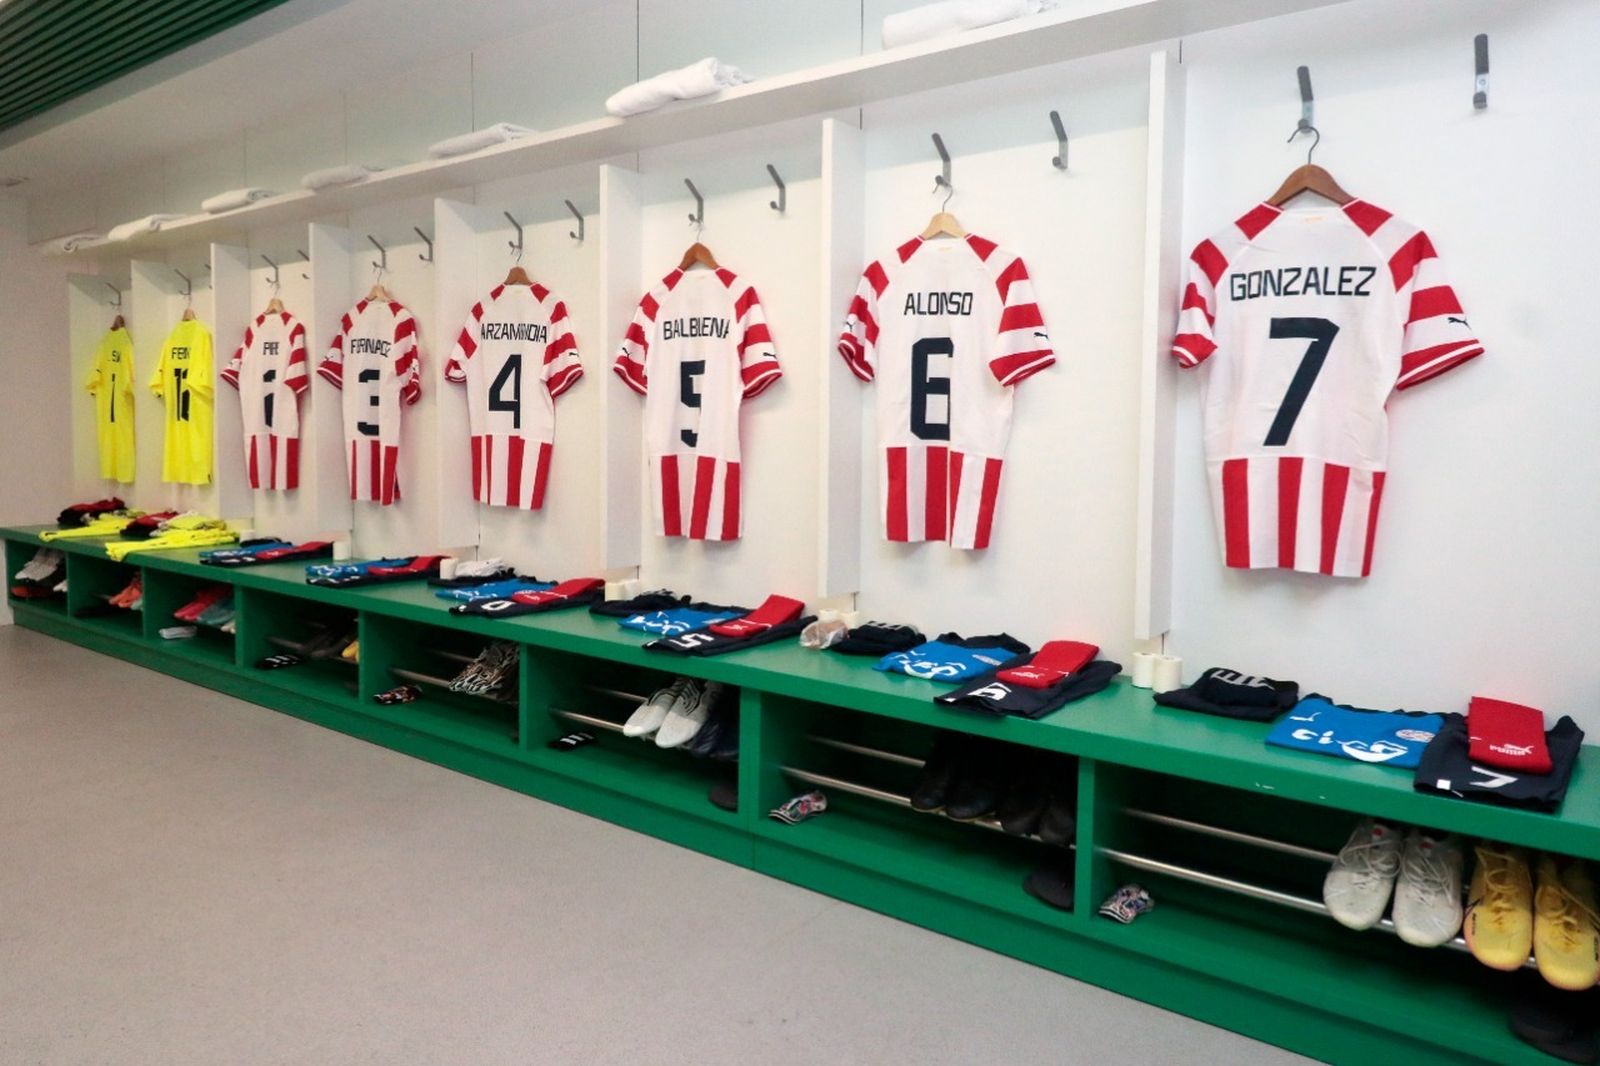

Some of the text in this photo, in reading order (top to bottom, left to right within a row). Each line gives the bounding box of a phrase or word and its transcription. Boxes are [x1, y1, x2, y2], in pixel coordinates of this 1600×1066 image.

[904, 291, 973, 316] ALONSO
[1230, 266, 1377, 301] GONZALEZ
[357, 368, 380, 436] 3
[489, 354, 521, 429] 4
[680, 360, 706, 447] 5
[910, 337, 954, 441] 6
[1263, 317, 1340, 446] 7
[1469, 765, 1518, 788] 7
